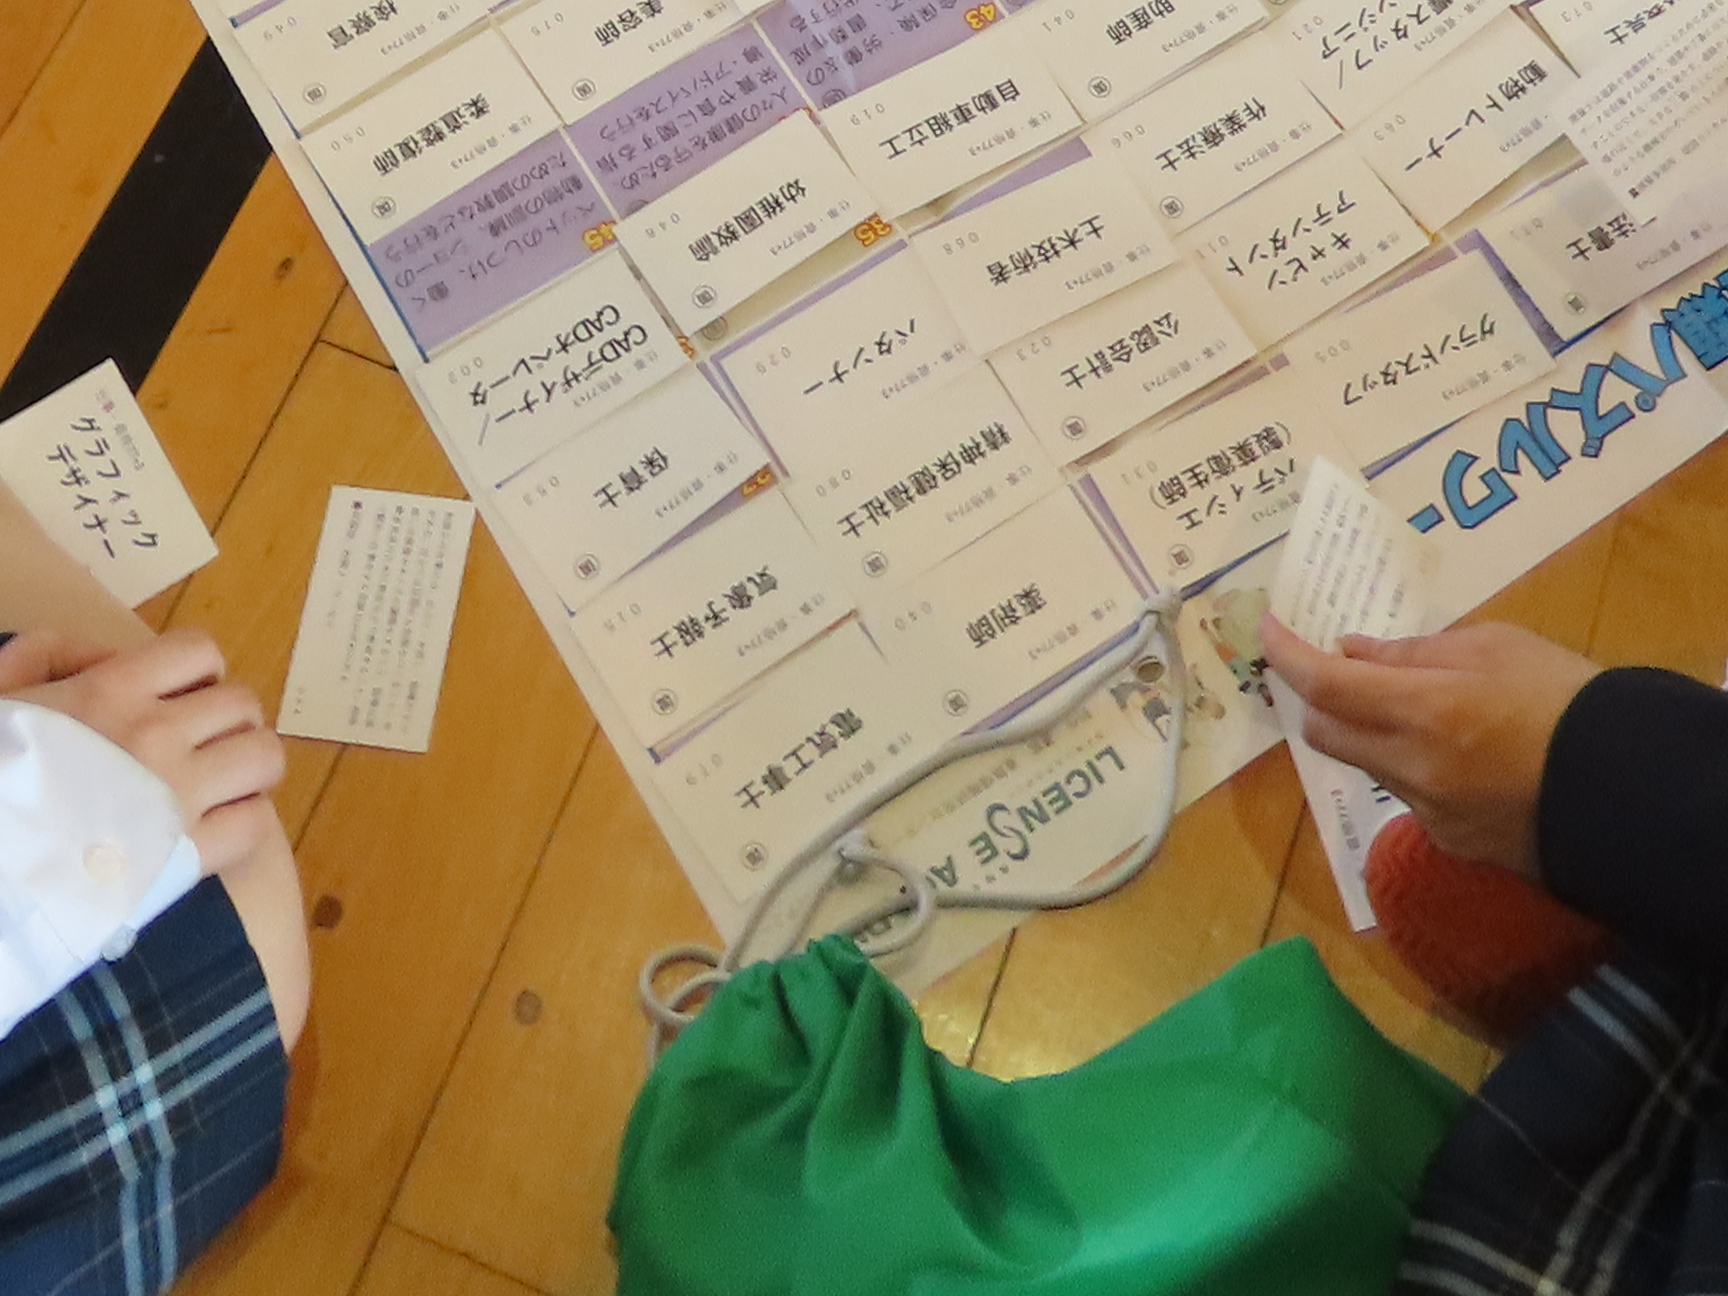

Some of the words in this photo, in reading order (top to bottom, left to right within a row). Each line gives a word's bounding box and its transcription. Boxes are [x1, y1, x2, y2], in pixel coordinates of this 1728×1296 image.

[373, 93, 489, 175] 柔道整復師
[879, 79, 1019, 158] 自動車組立工
[1155, 97, 1266, 170] 作業療法士
[1405, 60, 1546, 170] 動物トレーナー
[688, 179, 805, 260] 幼稚園教諭
[986, 215, 1103, 285] 土木技術者
[1226, 190, 1355, 275] アテンダント
[1566, 212, 1656, 260] 法書士
[1268, 232, 1350, 289] キャビン
[469, 304, 619, 406] CADオペレータ
[803, 318, 914, 394] パタンナー
[1060, 312, 1178, 388] 公認会計士
[1344, 313, 1494, 405] グランドスタッフ
[46, 443, 117, 560] デザイナー
[71, 416, 160, 549] グラフィック
[594, 447, 667, 507] 保育士
[837, 422, 1011, 536] 精神保健福祉士
[1176, 458, 1294, 529] パティシエ
[650, 566, 776, 656] 気象予報士
[966, 583, 1046, 647] 薬剤師
[735, 708, 862, 808] 電気工事士
[966, 743, 1129, 862] LICENSE
